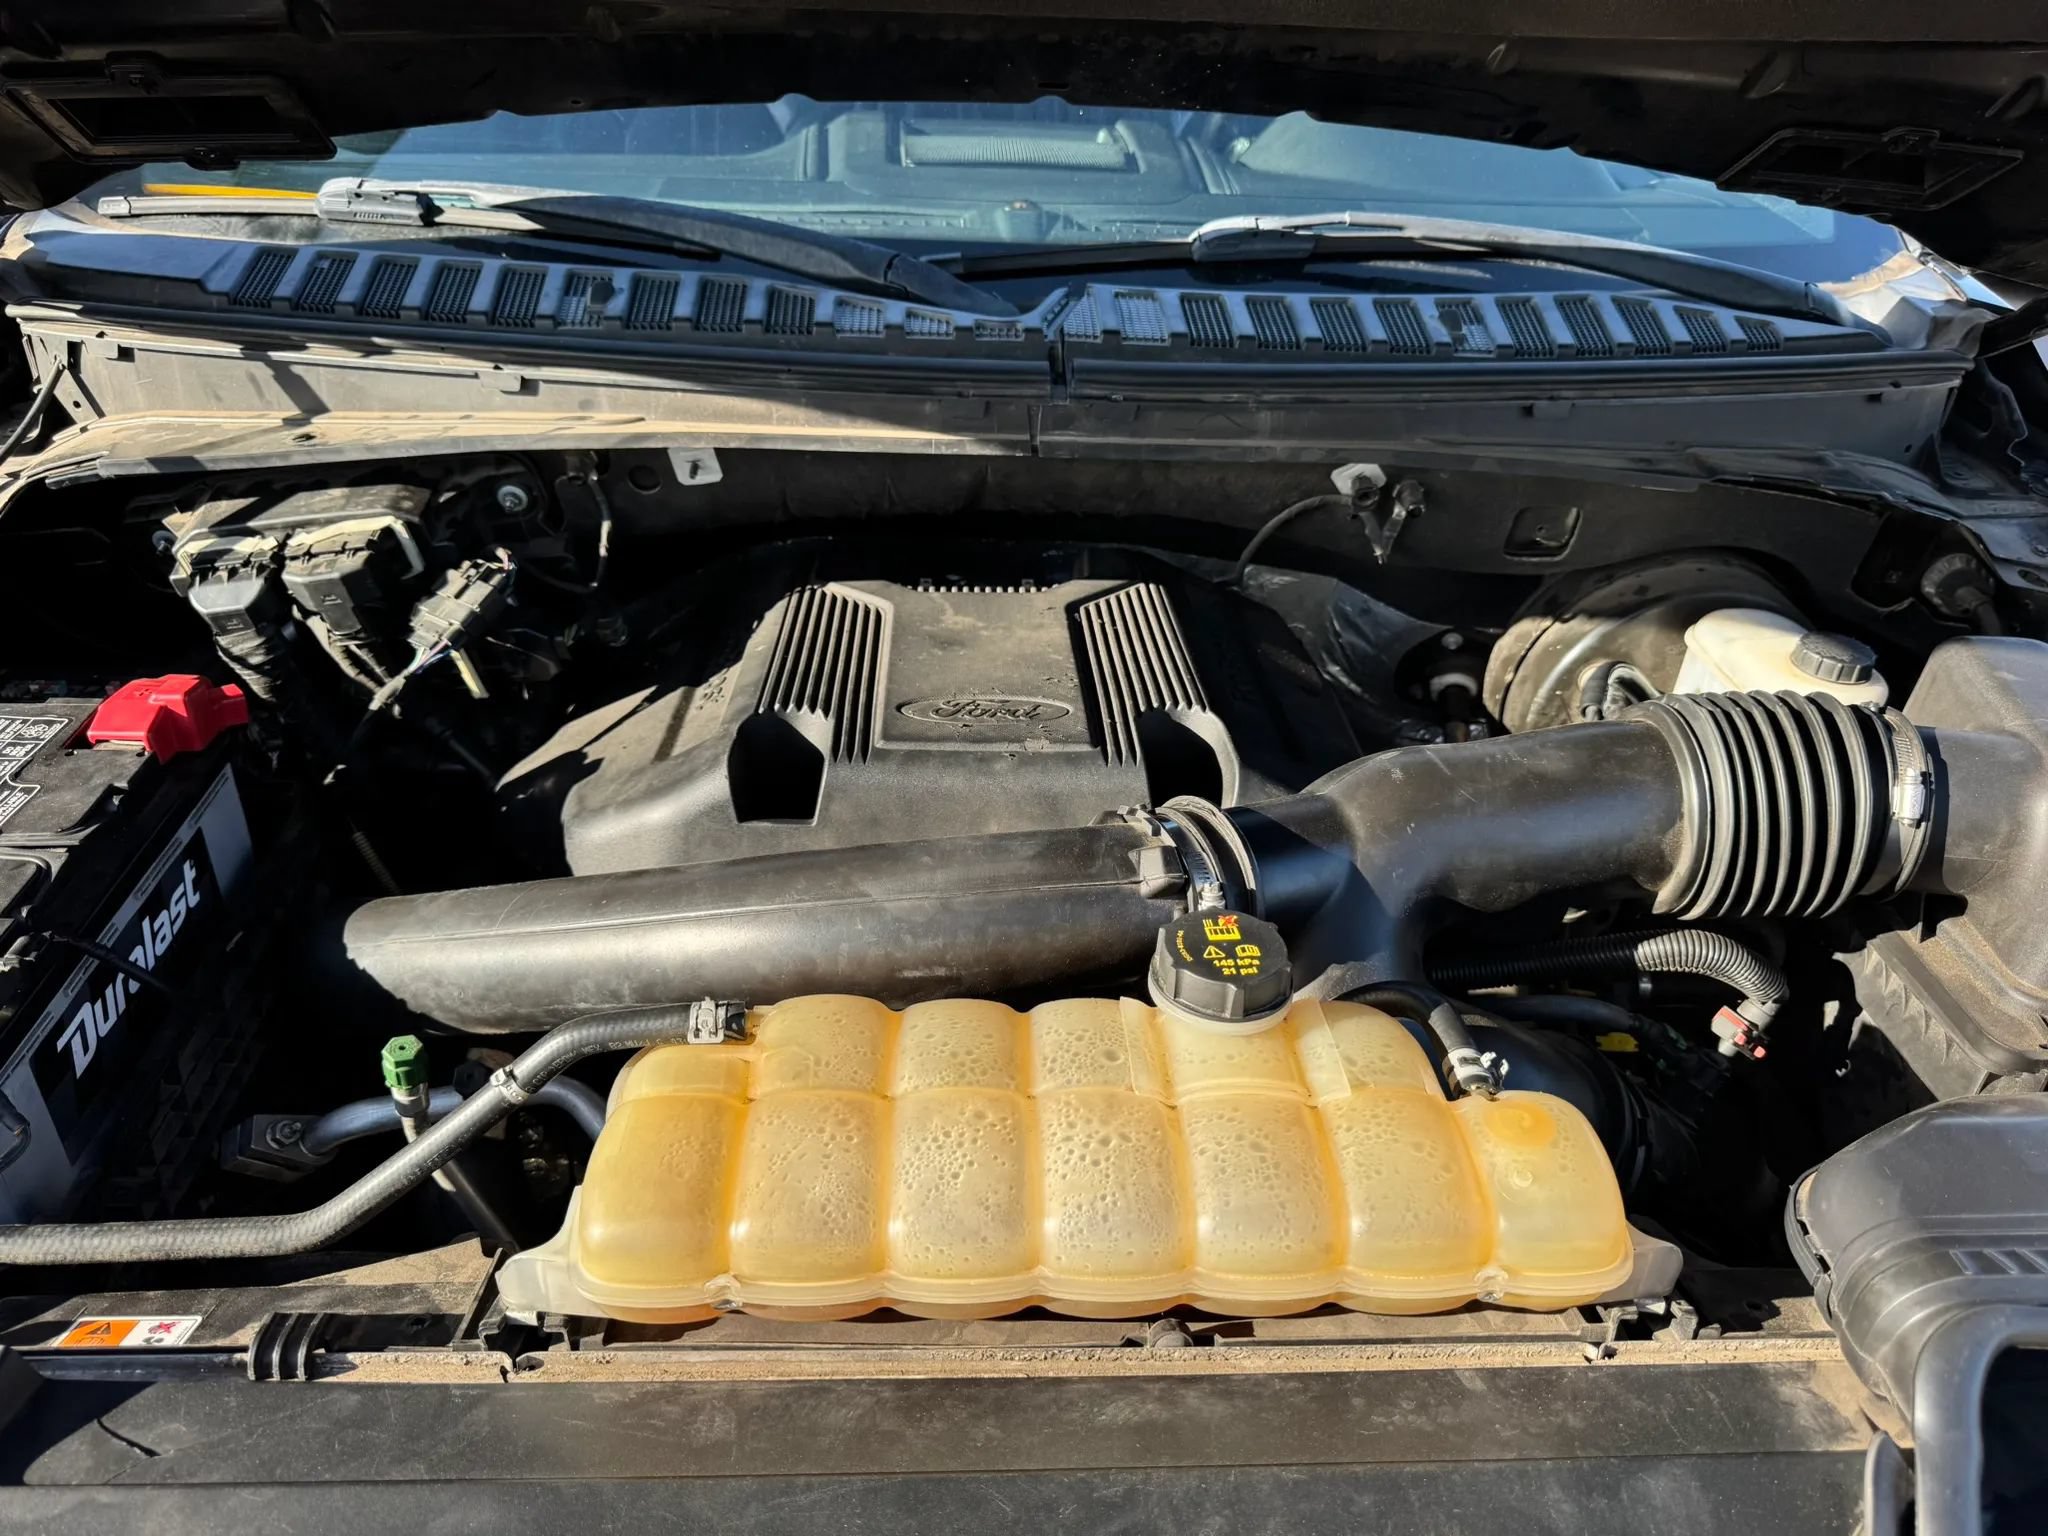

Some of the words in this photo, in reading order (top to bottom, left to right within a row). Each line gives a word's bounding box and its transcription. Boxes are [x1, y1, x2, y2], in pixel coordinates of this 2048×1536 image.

[932, 698, 1042, 720] Ford
[57, 859, 201, 1079] Duralast
[1213, 959, 1235, 967] 145
[1236, 958, 1261, 966] kPa
[1221, 967, 1237, 975] 21
[1239, 966, 1259, 976] psi
